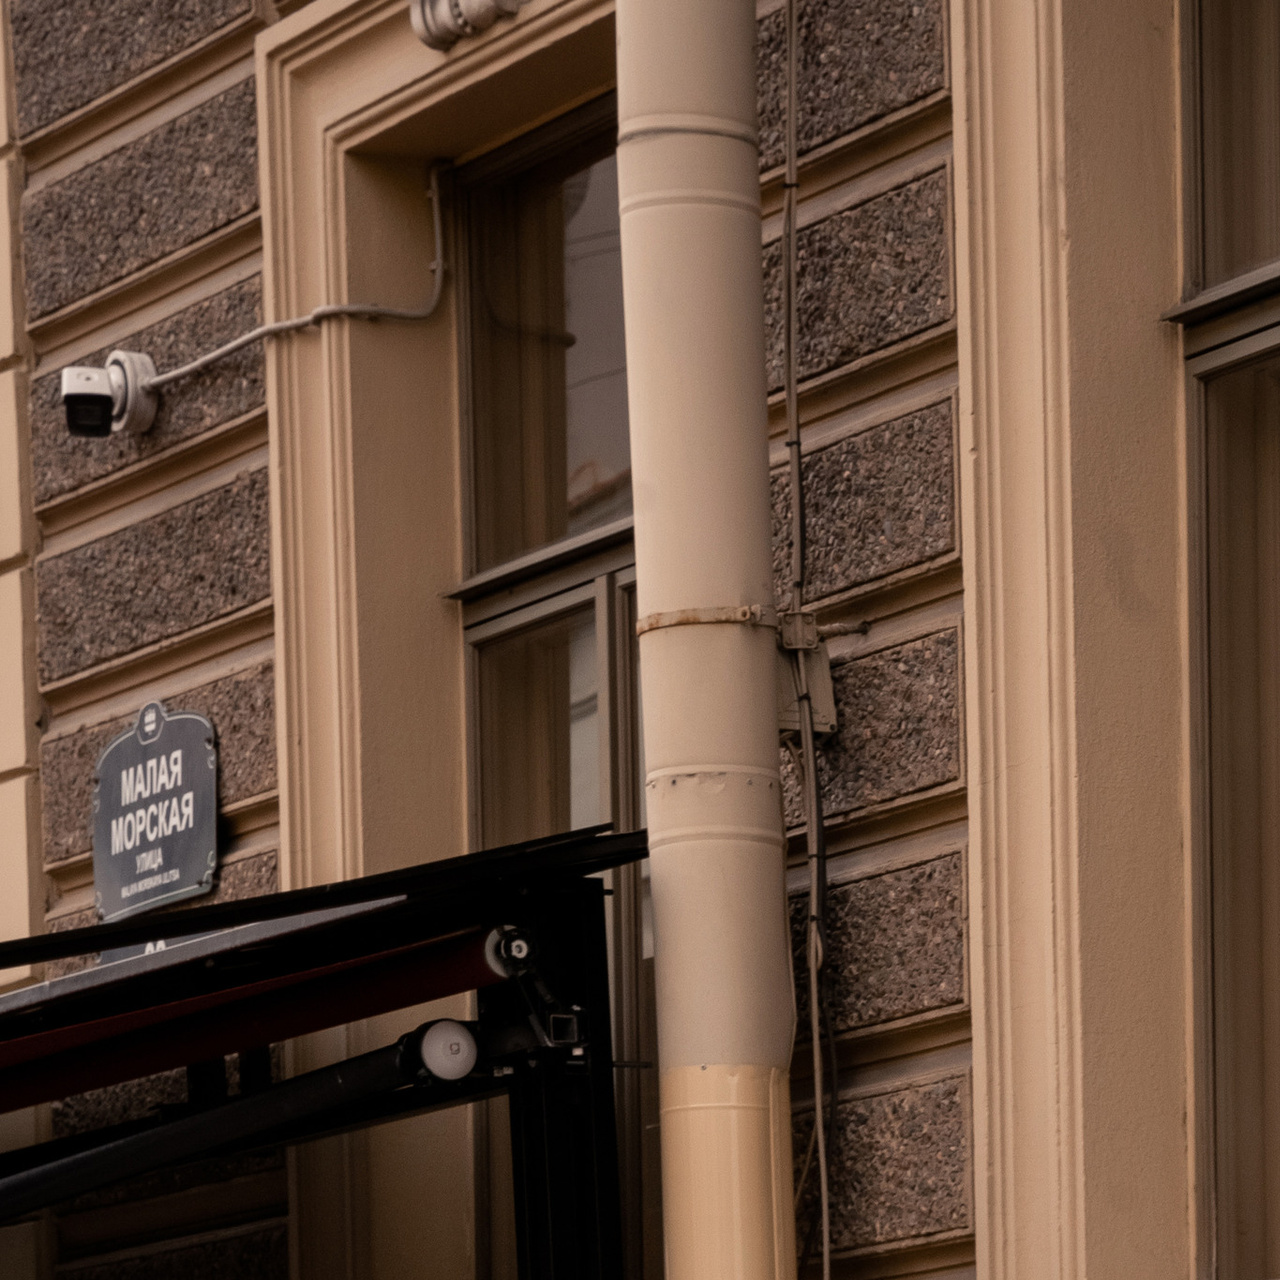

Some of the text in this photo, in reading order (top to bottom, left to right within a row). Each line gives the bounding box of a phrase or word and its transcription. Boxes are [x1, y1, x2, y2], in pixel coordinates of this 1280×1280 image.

[121, 749, 182, 807] МАЛАЯ
[111, 791, 194, 856] МОРСКАЯ
[135, 847, 163, 875] УЛИЦА
